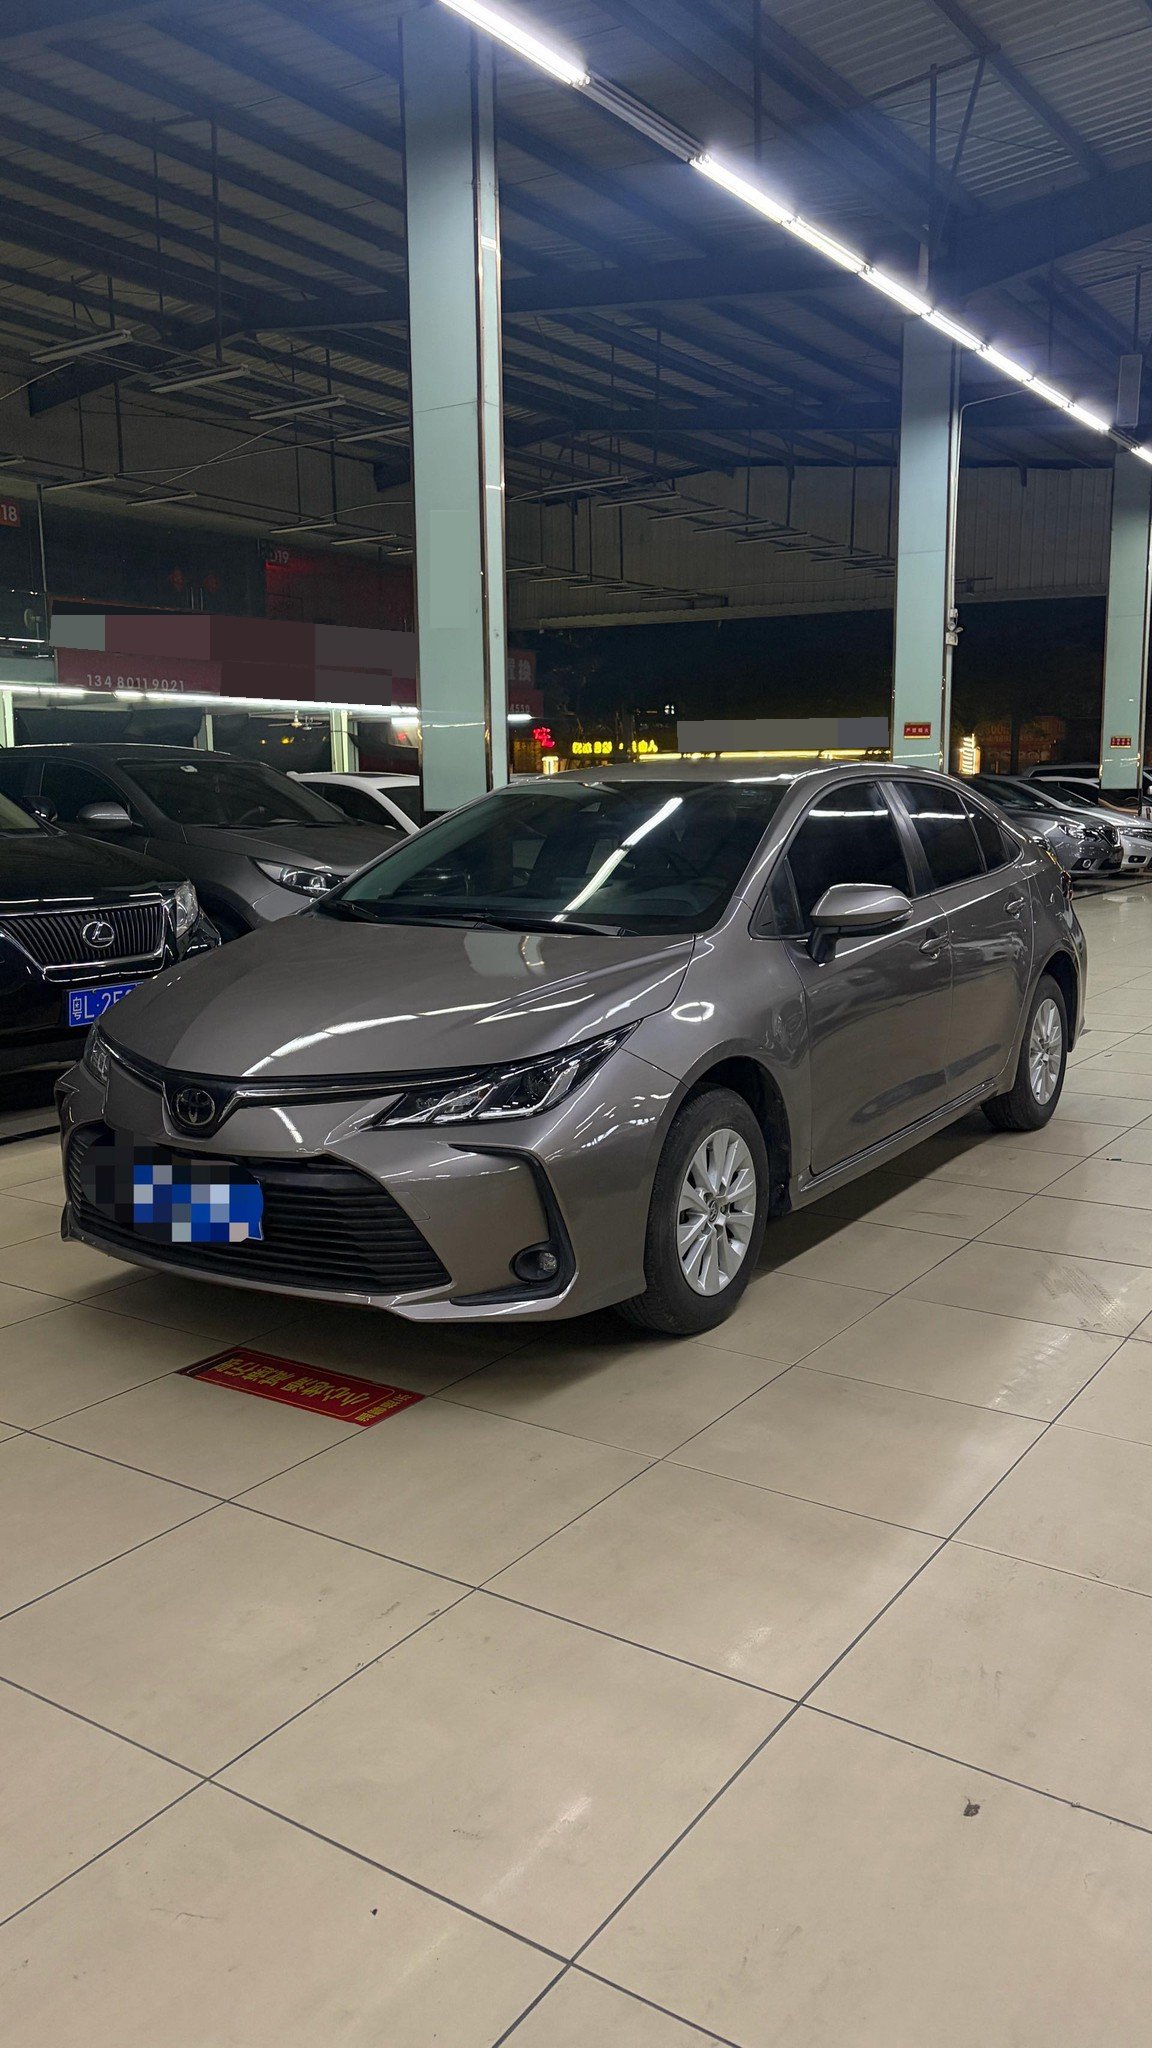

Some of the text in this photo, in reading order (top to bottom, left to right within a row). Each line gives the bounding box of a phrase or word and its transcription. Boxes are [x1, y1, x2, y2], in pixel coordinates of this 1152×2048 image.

[86, 674, 184, 692] 134 8011 9021
[211, 1358, 371, 1407] 小心地滑 减速行驶
